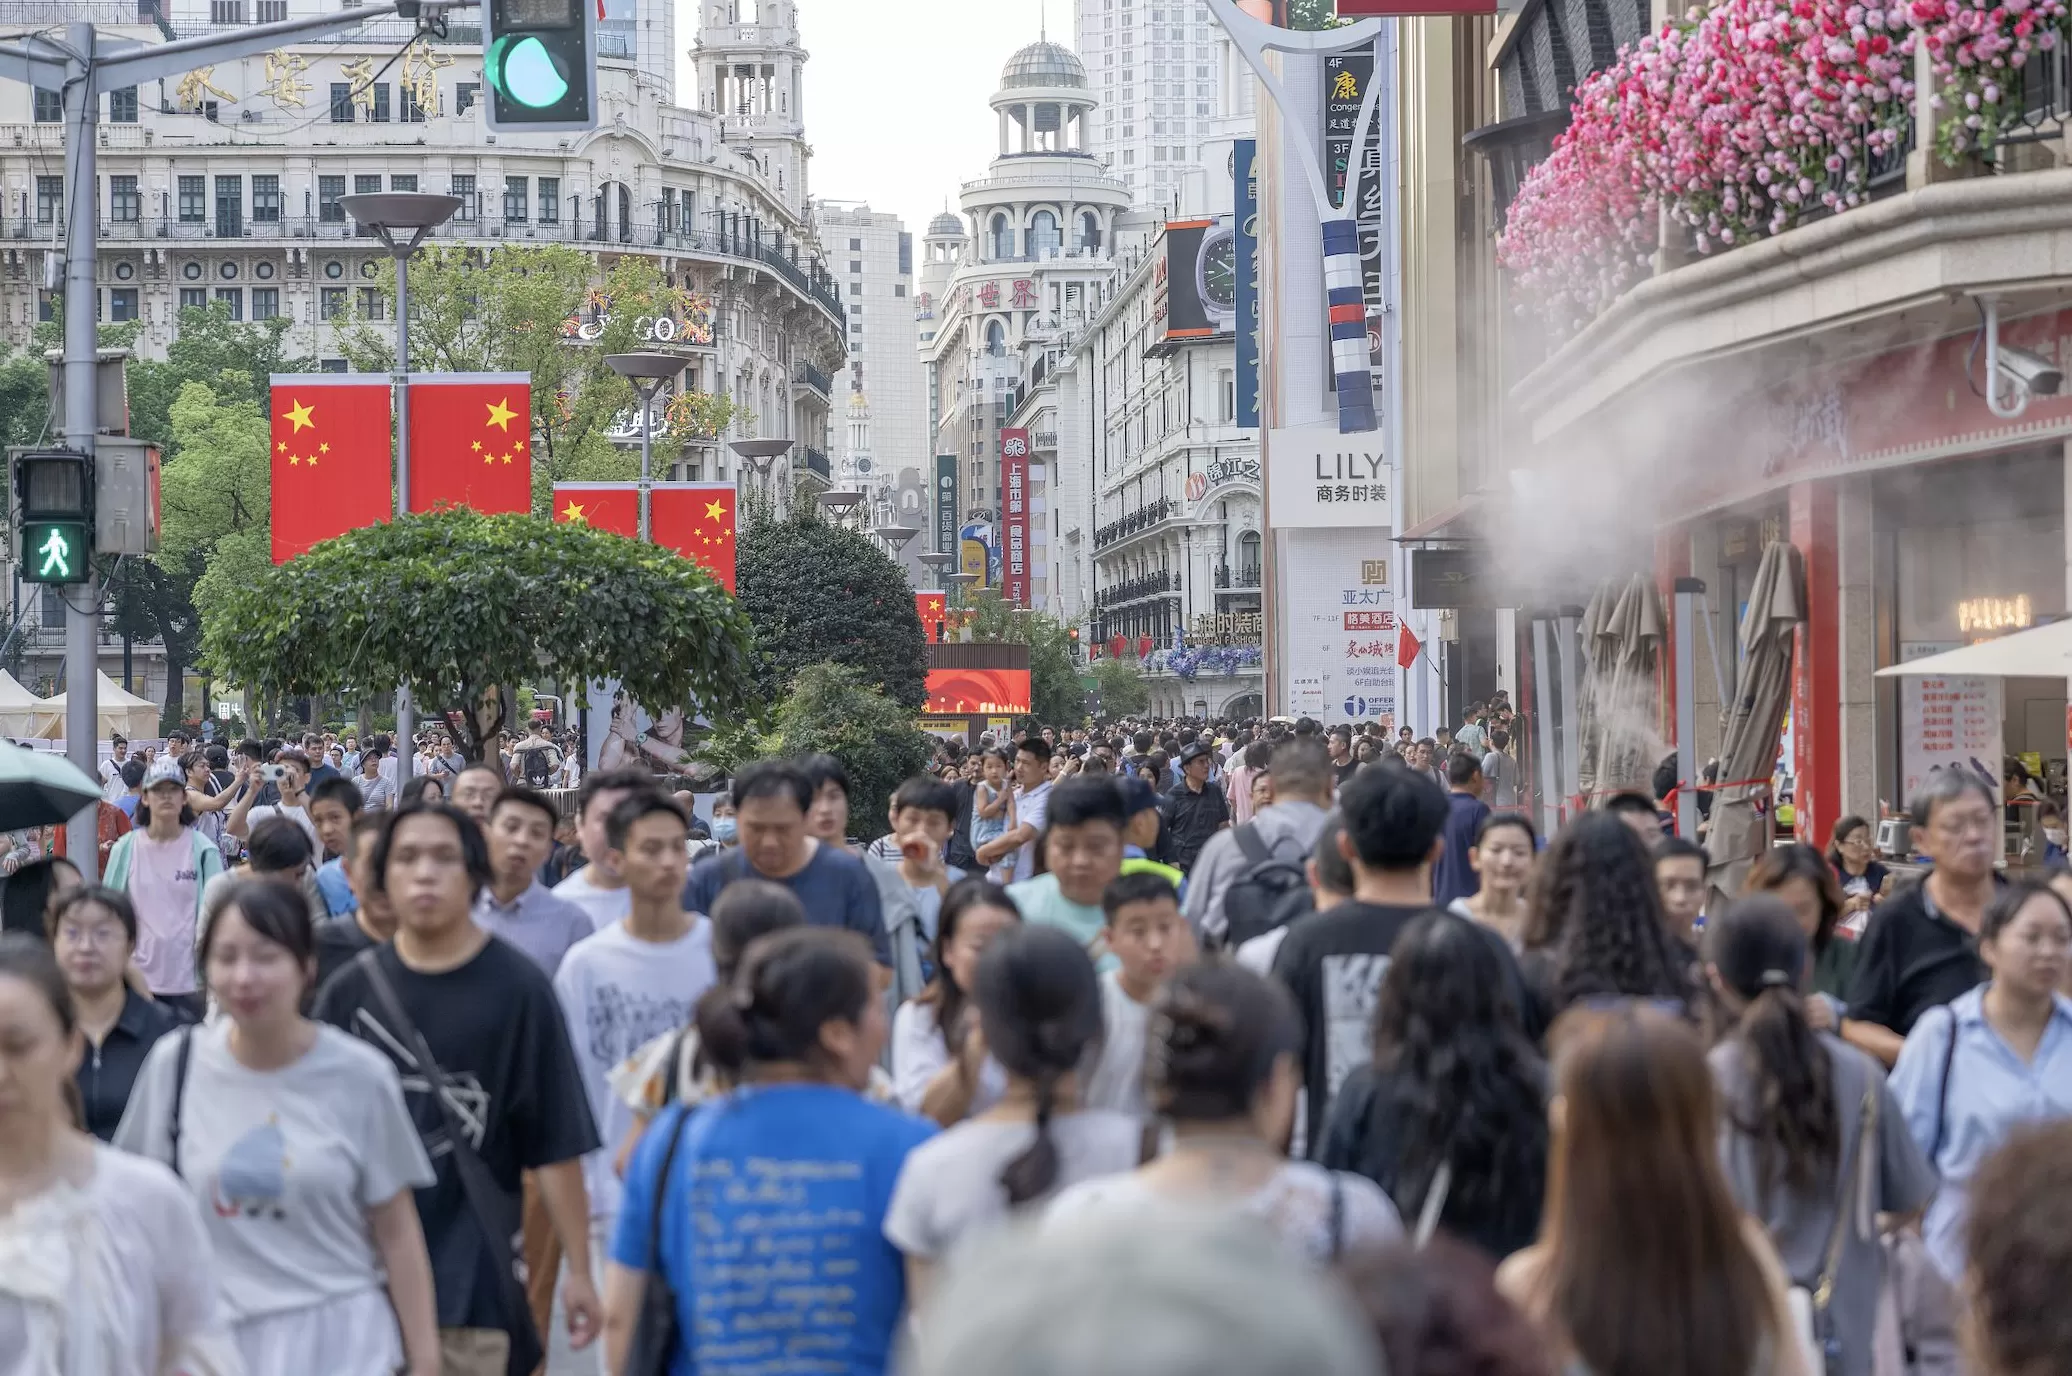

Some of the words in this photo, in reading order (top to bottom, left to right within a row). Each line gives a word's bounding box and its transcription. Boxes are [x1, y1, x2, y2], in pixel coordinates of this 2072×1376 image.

[1329, 57, 1342, 68] 4F
[1331, 71, 1358, 100] 康
[1334, 144, 1349, 153] 3F
[1316, 453, 1384, 480] LILY
[1316, 484, 1388, 504] 商务时装
[1009, 462, 1024, 575] 上海市第一食品商店
[941, 491, 953, 573] 第一百货商业心
[1342, 589, 1394, 605] 亚太广
[1225, 635, 1259, 644] FASHION
